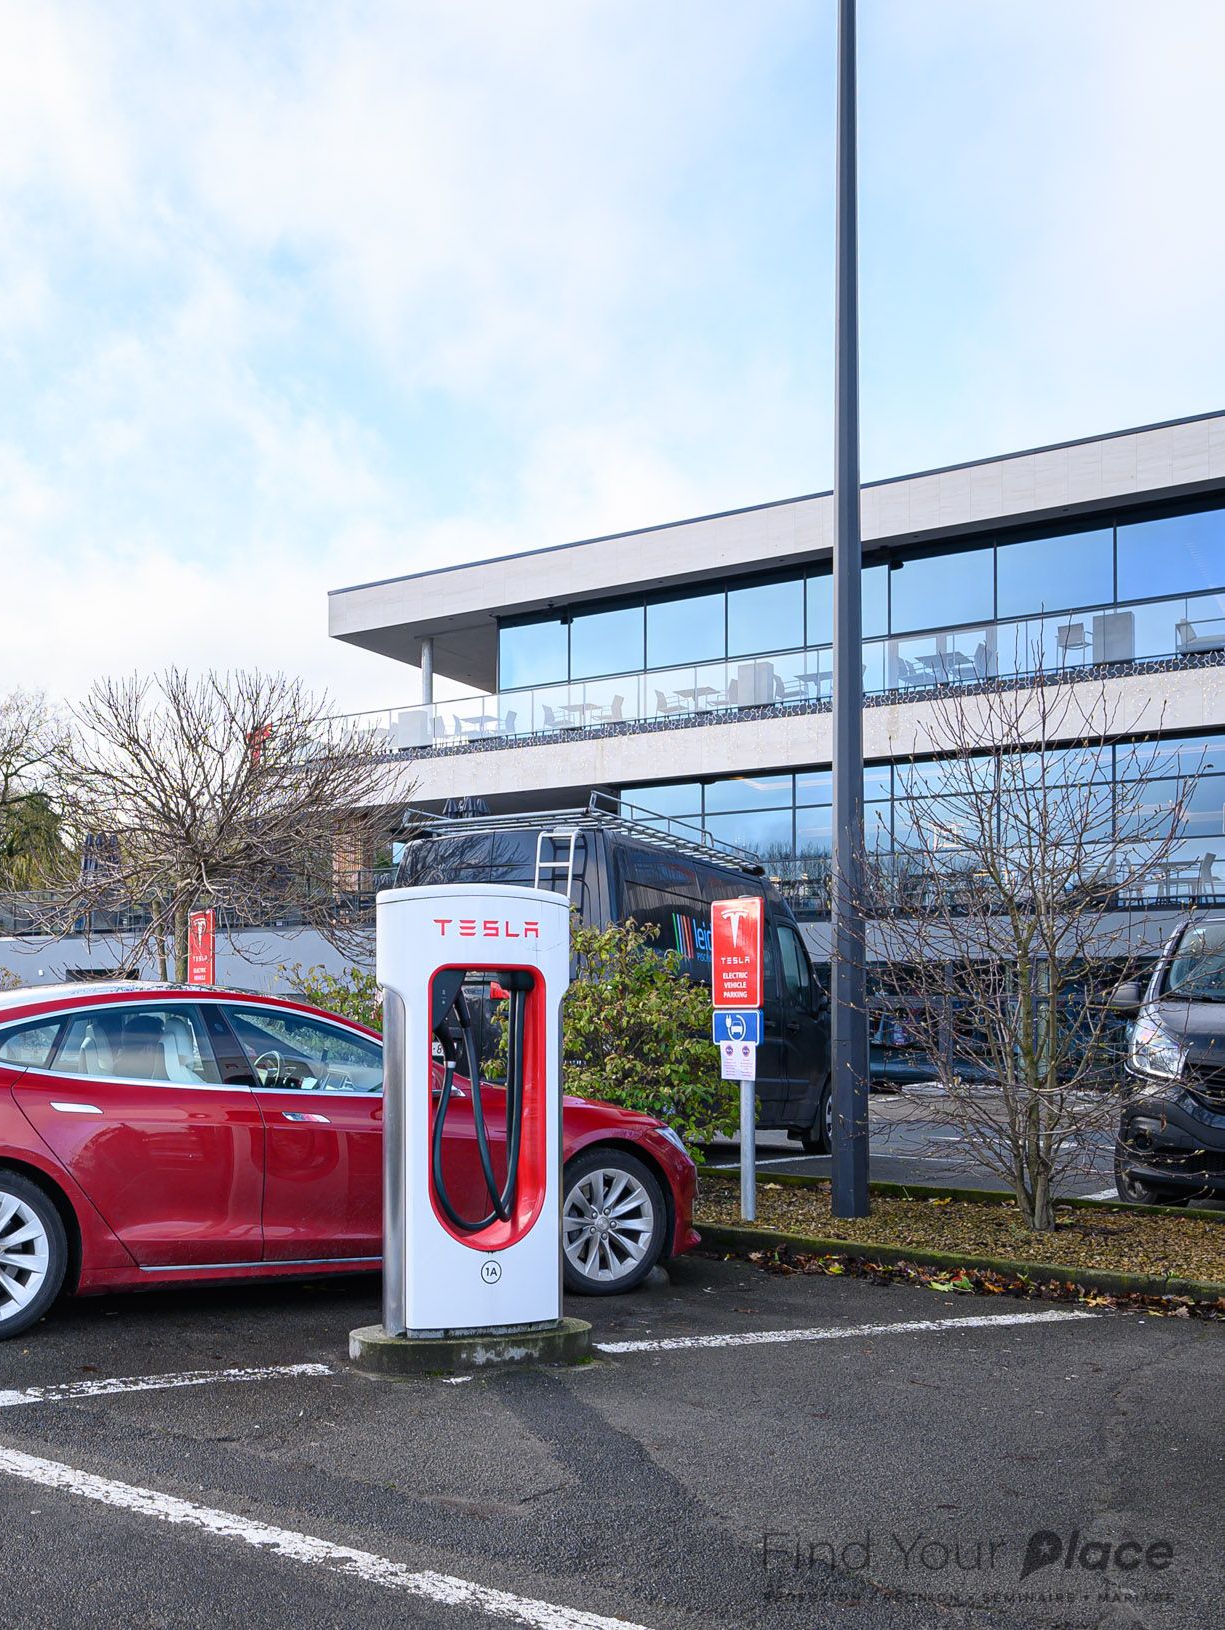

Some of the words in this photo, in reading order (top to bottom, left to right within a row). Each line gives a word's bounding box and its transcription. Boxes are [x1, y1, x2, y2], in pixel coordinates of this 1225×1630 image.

[433, 918, 540, 939] TESLA
[720, 956, 750, 965] TESLA
[722, 971, 748, 980] ELECTRIC
[723, 981, 747, 989] VEHICLE
[723, 990, 748, 999] PARKING
[485, 1267, 498, 1277] 1A
